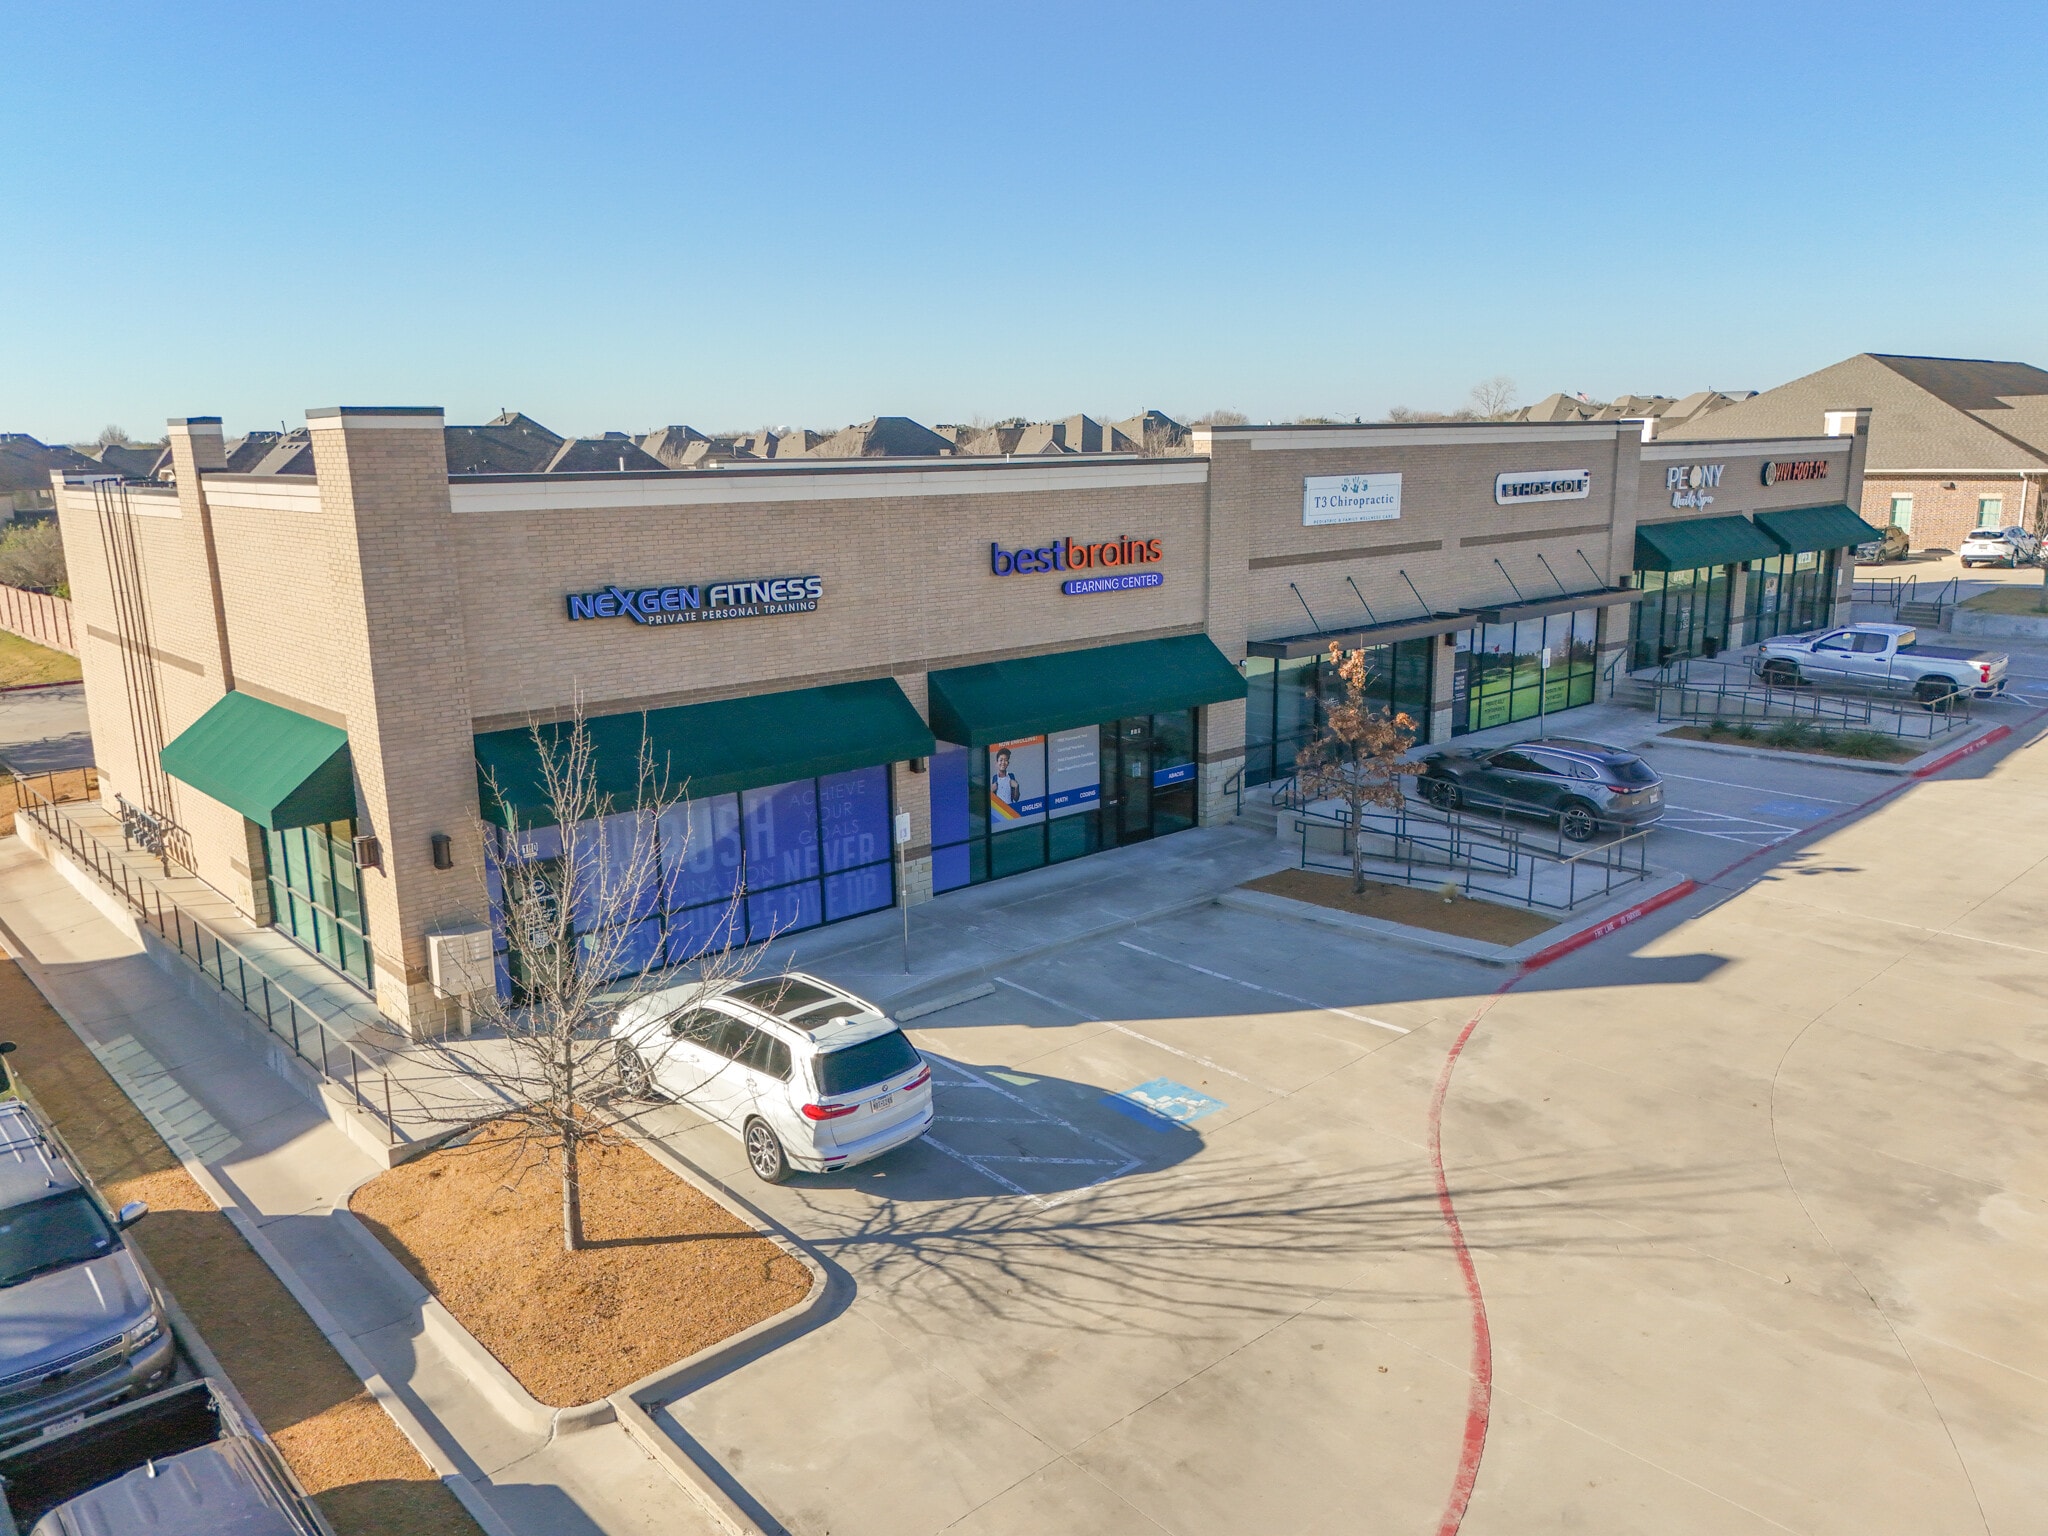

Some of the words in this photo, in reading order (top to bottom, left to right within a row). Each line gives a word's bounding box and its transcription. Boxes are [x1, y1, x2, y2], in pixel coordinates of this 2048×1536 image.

[1502, 481, 1552, 497] ETHOS
[1552, 479, 1588, 493] GOLF
[1314, 496, 1328, 508] T3
[1330, 493, 1395, 508] Chiropractic
[1070, 577, 1119, 594] LEARNING
[1121, 574, 1159, 588] CENTER
[568, 586, 700, 623] NEXGEN
[707, 576, 824, 608] FITNESS
[648, 612, 697, 625] PRIVATE
[702, 606, 760, 621] PERSONAL
[763, 601, 817, 613] TRAINING
[789, 779, 865, 809] ACHIEVE
[1054, 796, 1069, 804] MATH
[803, 800, 853, 825] YOUR
[1021, 802, 1043, 812] ENGLISH
[797, 818, 859, 847] GOALS
[782, 830, 876, 892] NEVER
